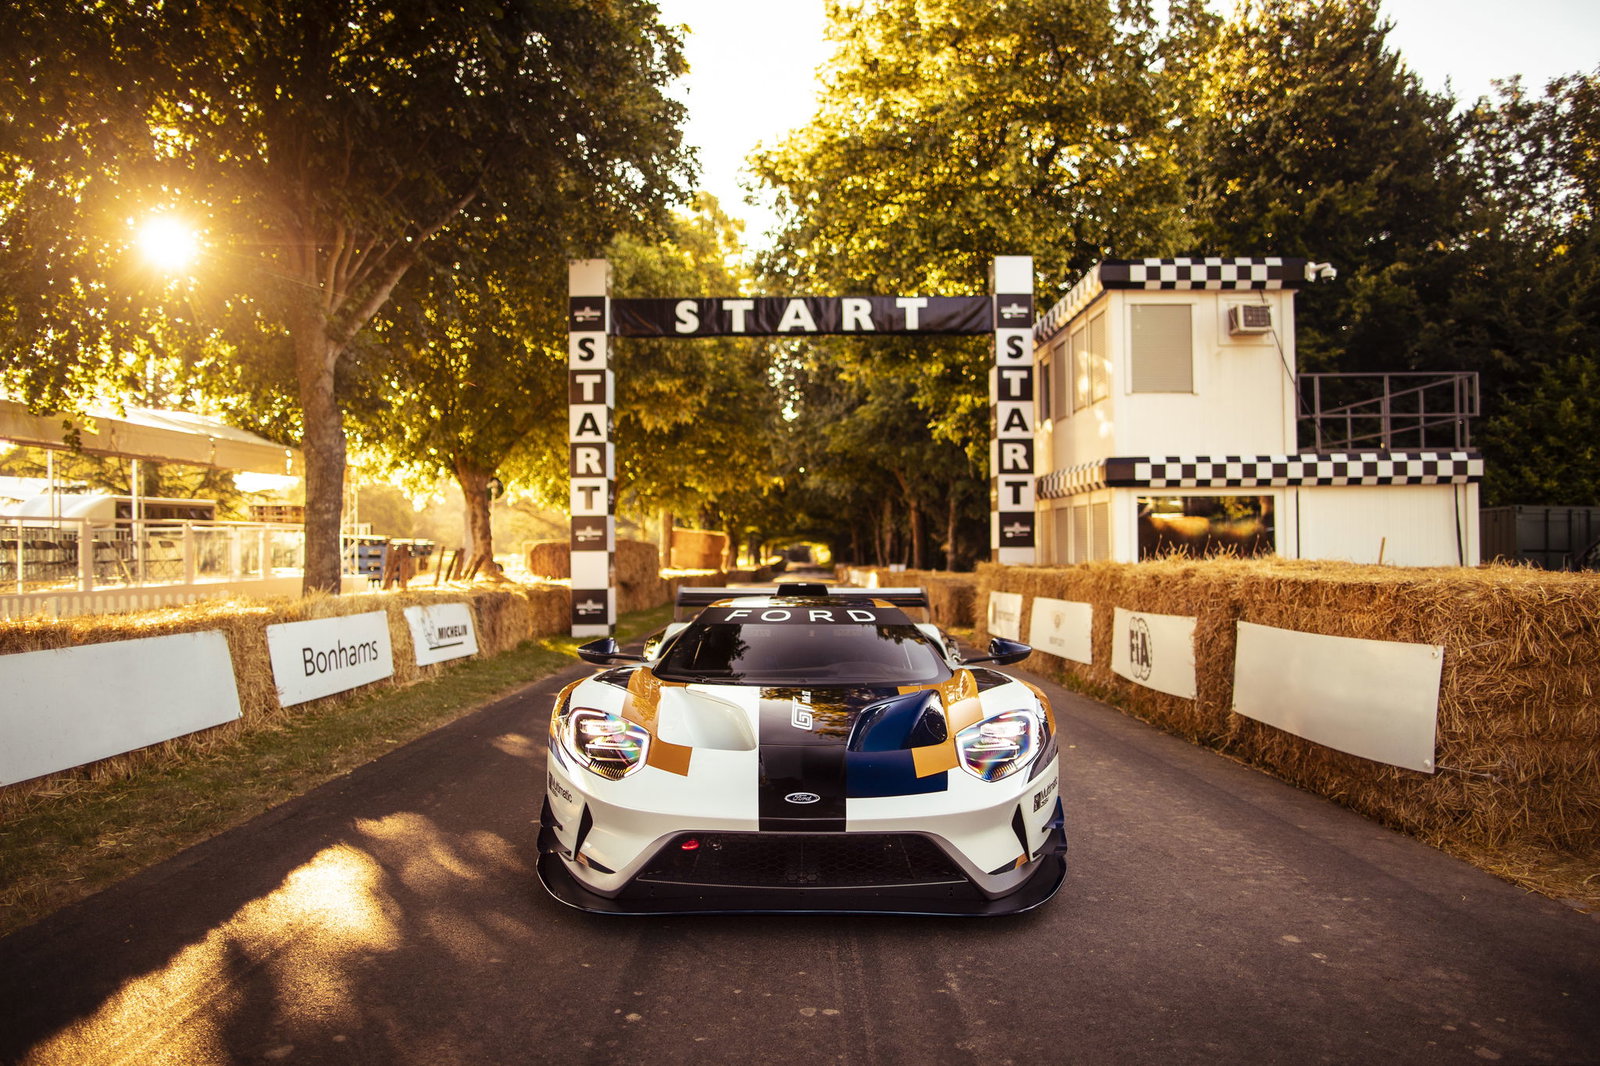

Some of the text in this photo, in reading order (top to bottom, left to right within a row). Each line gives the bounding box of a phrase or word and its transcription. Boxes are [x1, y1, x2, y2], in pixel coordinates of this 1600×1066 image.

[675, 297, 928, 334] START
[575, 337, 602, 511] START
[1002, 335, 1029, 506] START
[437, 623, 468, 641] MICHELIN
[724, 609, 877, 623] FORD
[302, 639, 379, 678] Bonhams
[1129, 629, 1151, 668] FIA
[791, 695, 816, 731] GT
